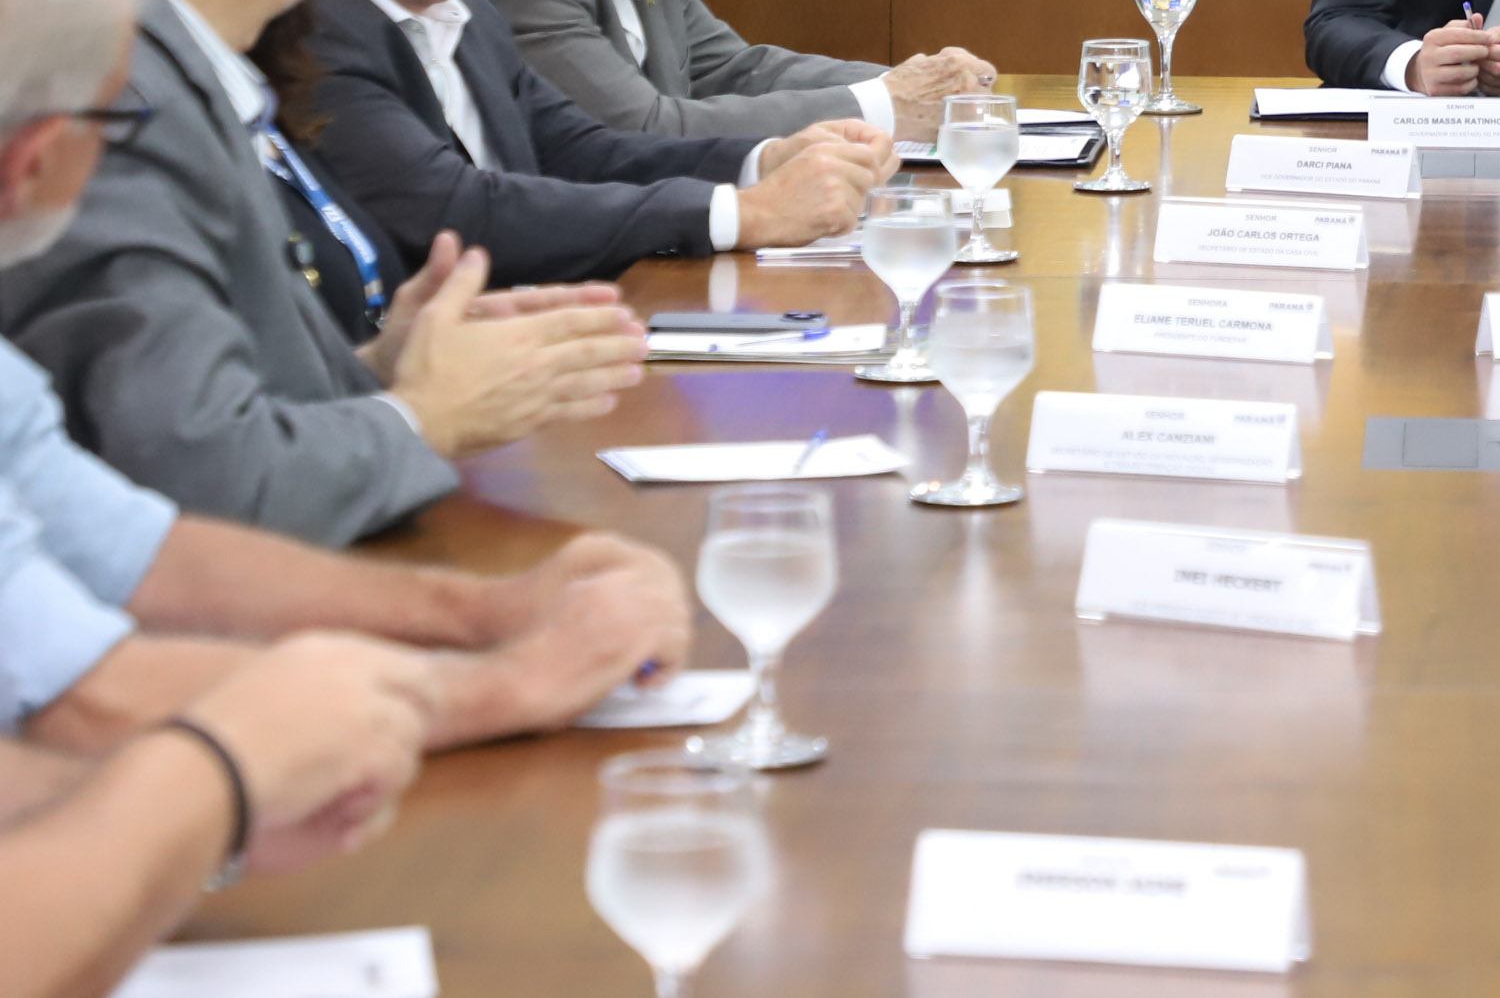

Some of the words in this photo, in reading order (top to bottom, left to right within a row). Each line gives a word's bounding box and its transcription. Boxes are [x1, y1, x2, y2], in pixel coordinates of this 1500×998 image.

[1393, 117, 1429, 125] CARLOS
[1431, 117, 1462, 125] MASSA
[1308, 146, 1338, 154] SENHOR
[1296, 160, 1324, 169] DARCI
[1325, 161, 1353, 170] PIANA
[1245, 214, 1277, 222] SENHOR
[1207, 227, 1235, 238] JOÃO
[1237, 230, 1277, 240] CARLOS
[1279, 232, 1320, 242] ORTEGA
[1134, 314, 1172, 325] ELIANE
[1175, 316, 1216, 328] TERUEL
[1219, 319, 1273, 331] CARMONA
[1121, 430, 1153, 442] ALEX
